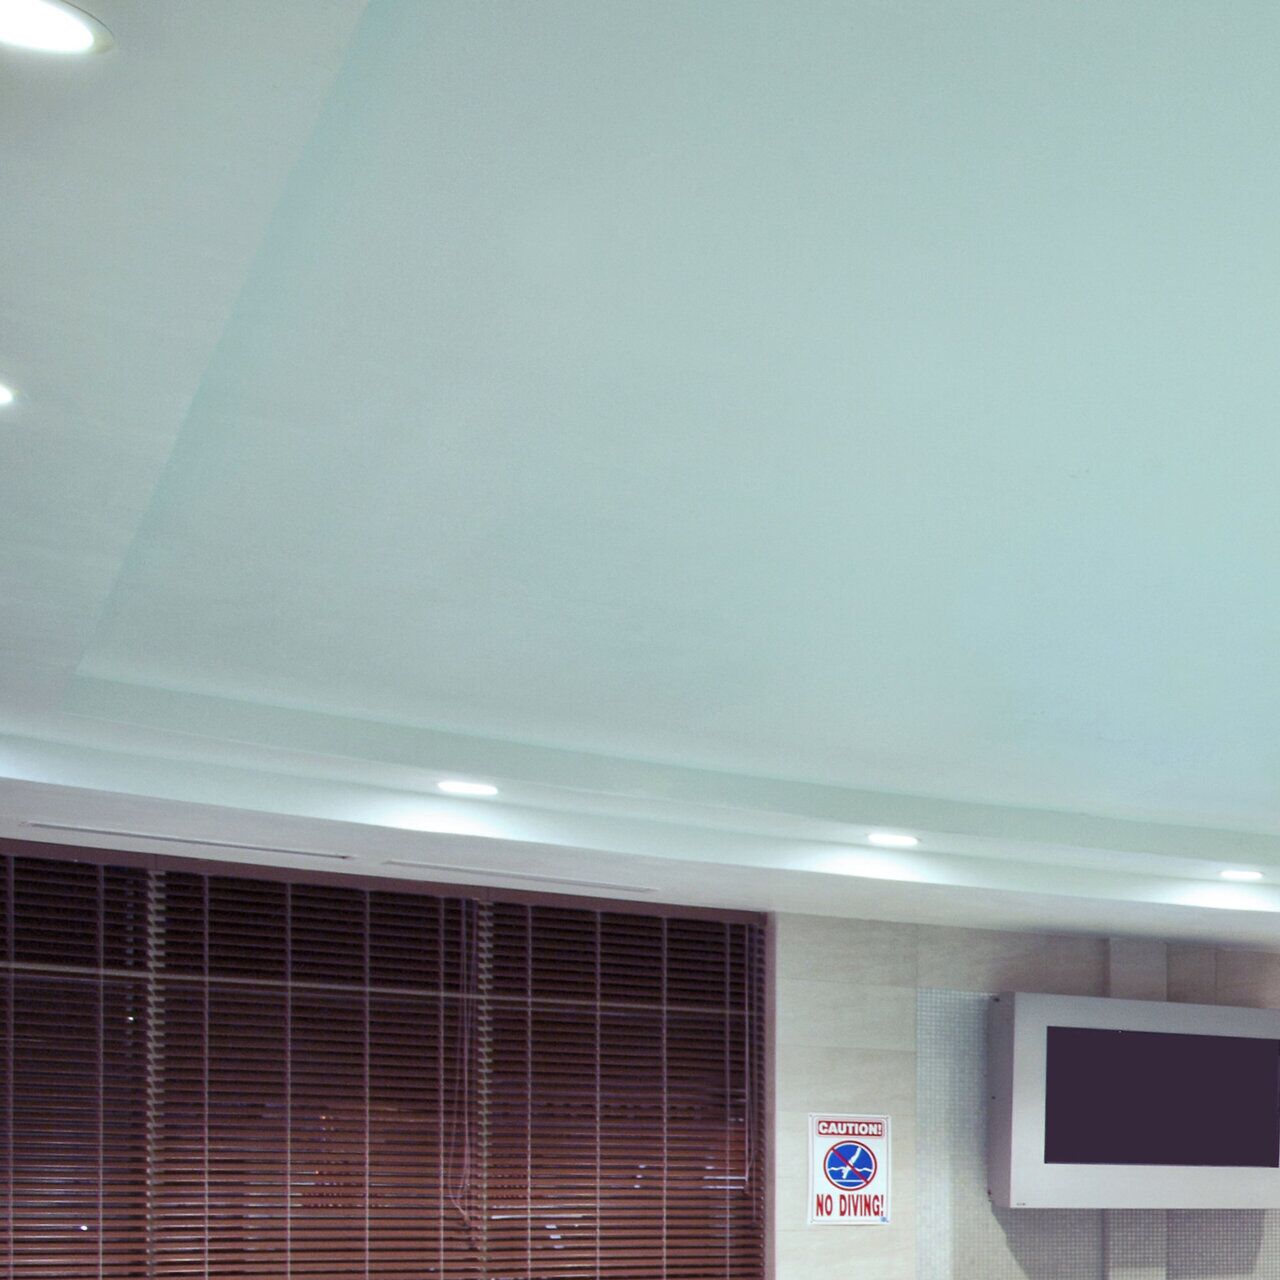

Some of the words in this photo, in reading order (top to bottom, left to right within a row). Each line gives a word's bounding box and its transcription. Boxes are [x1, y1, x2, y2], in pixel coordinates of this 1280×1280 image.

[819, 1122, 882, 1135] CAUTION!
[816, 1194, 833, 1216] NO
[839, 1194, 884, 1216] DIVING!
